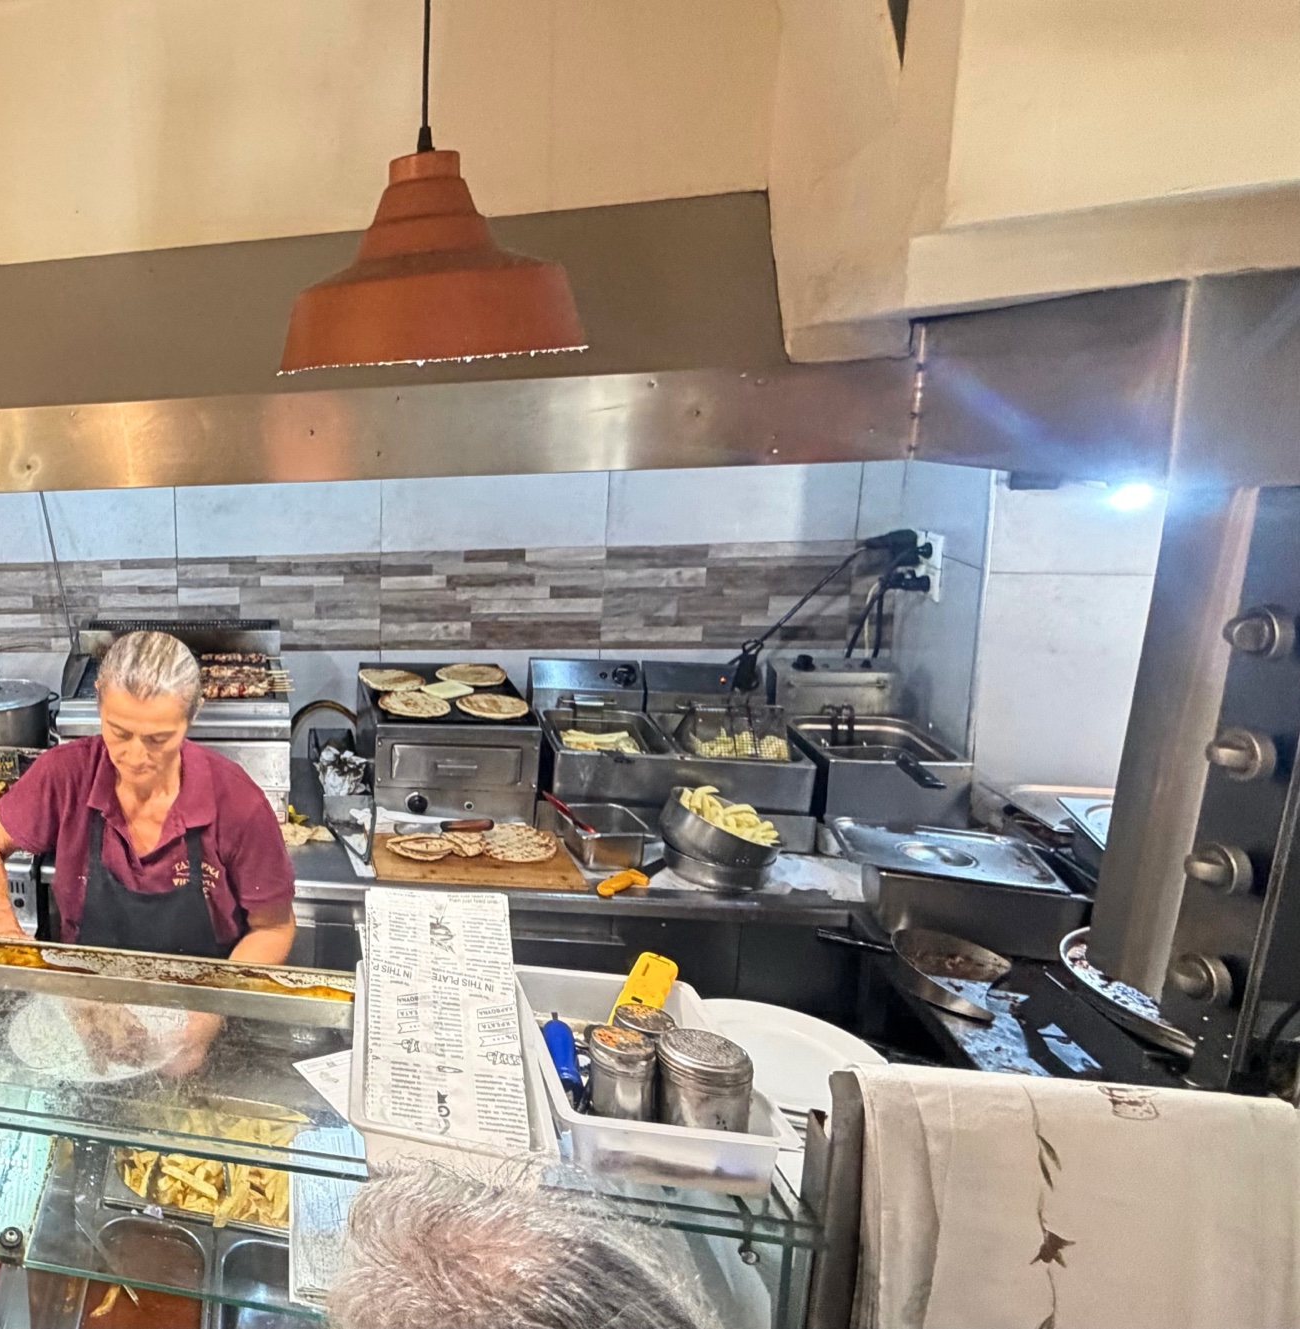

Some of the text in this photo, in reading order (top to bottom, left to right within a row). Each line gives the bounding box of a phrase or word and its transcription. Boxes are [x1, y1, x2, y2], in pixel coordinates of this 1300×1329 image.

[381, 964, 401, 977] THIS
[403, 970, 412, 979] IN
[431, 972, 494, 993] IN THIS PLATE
